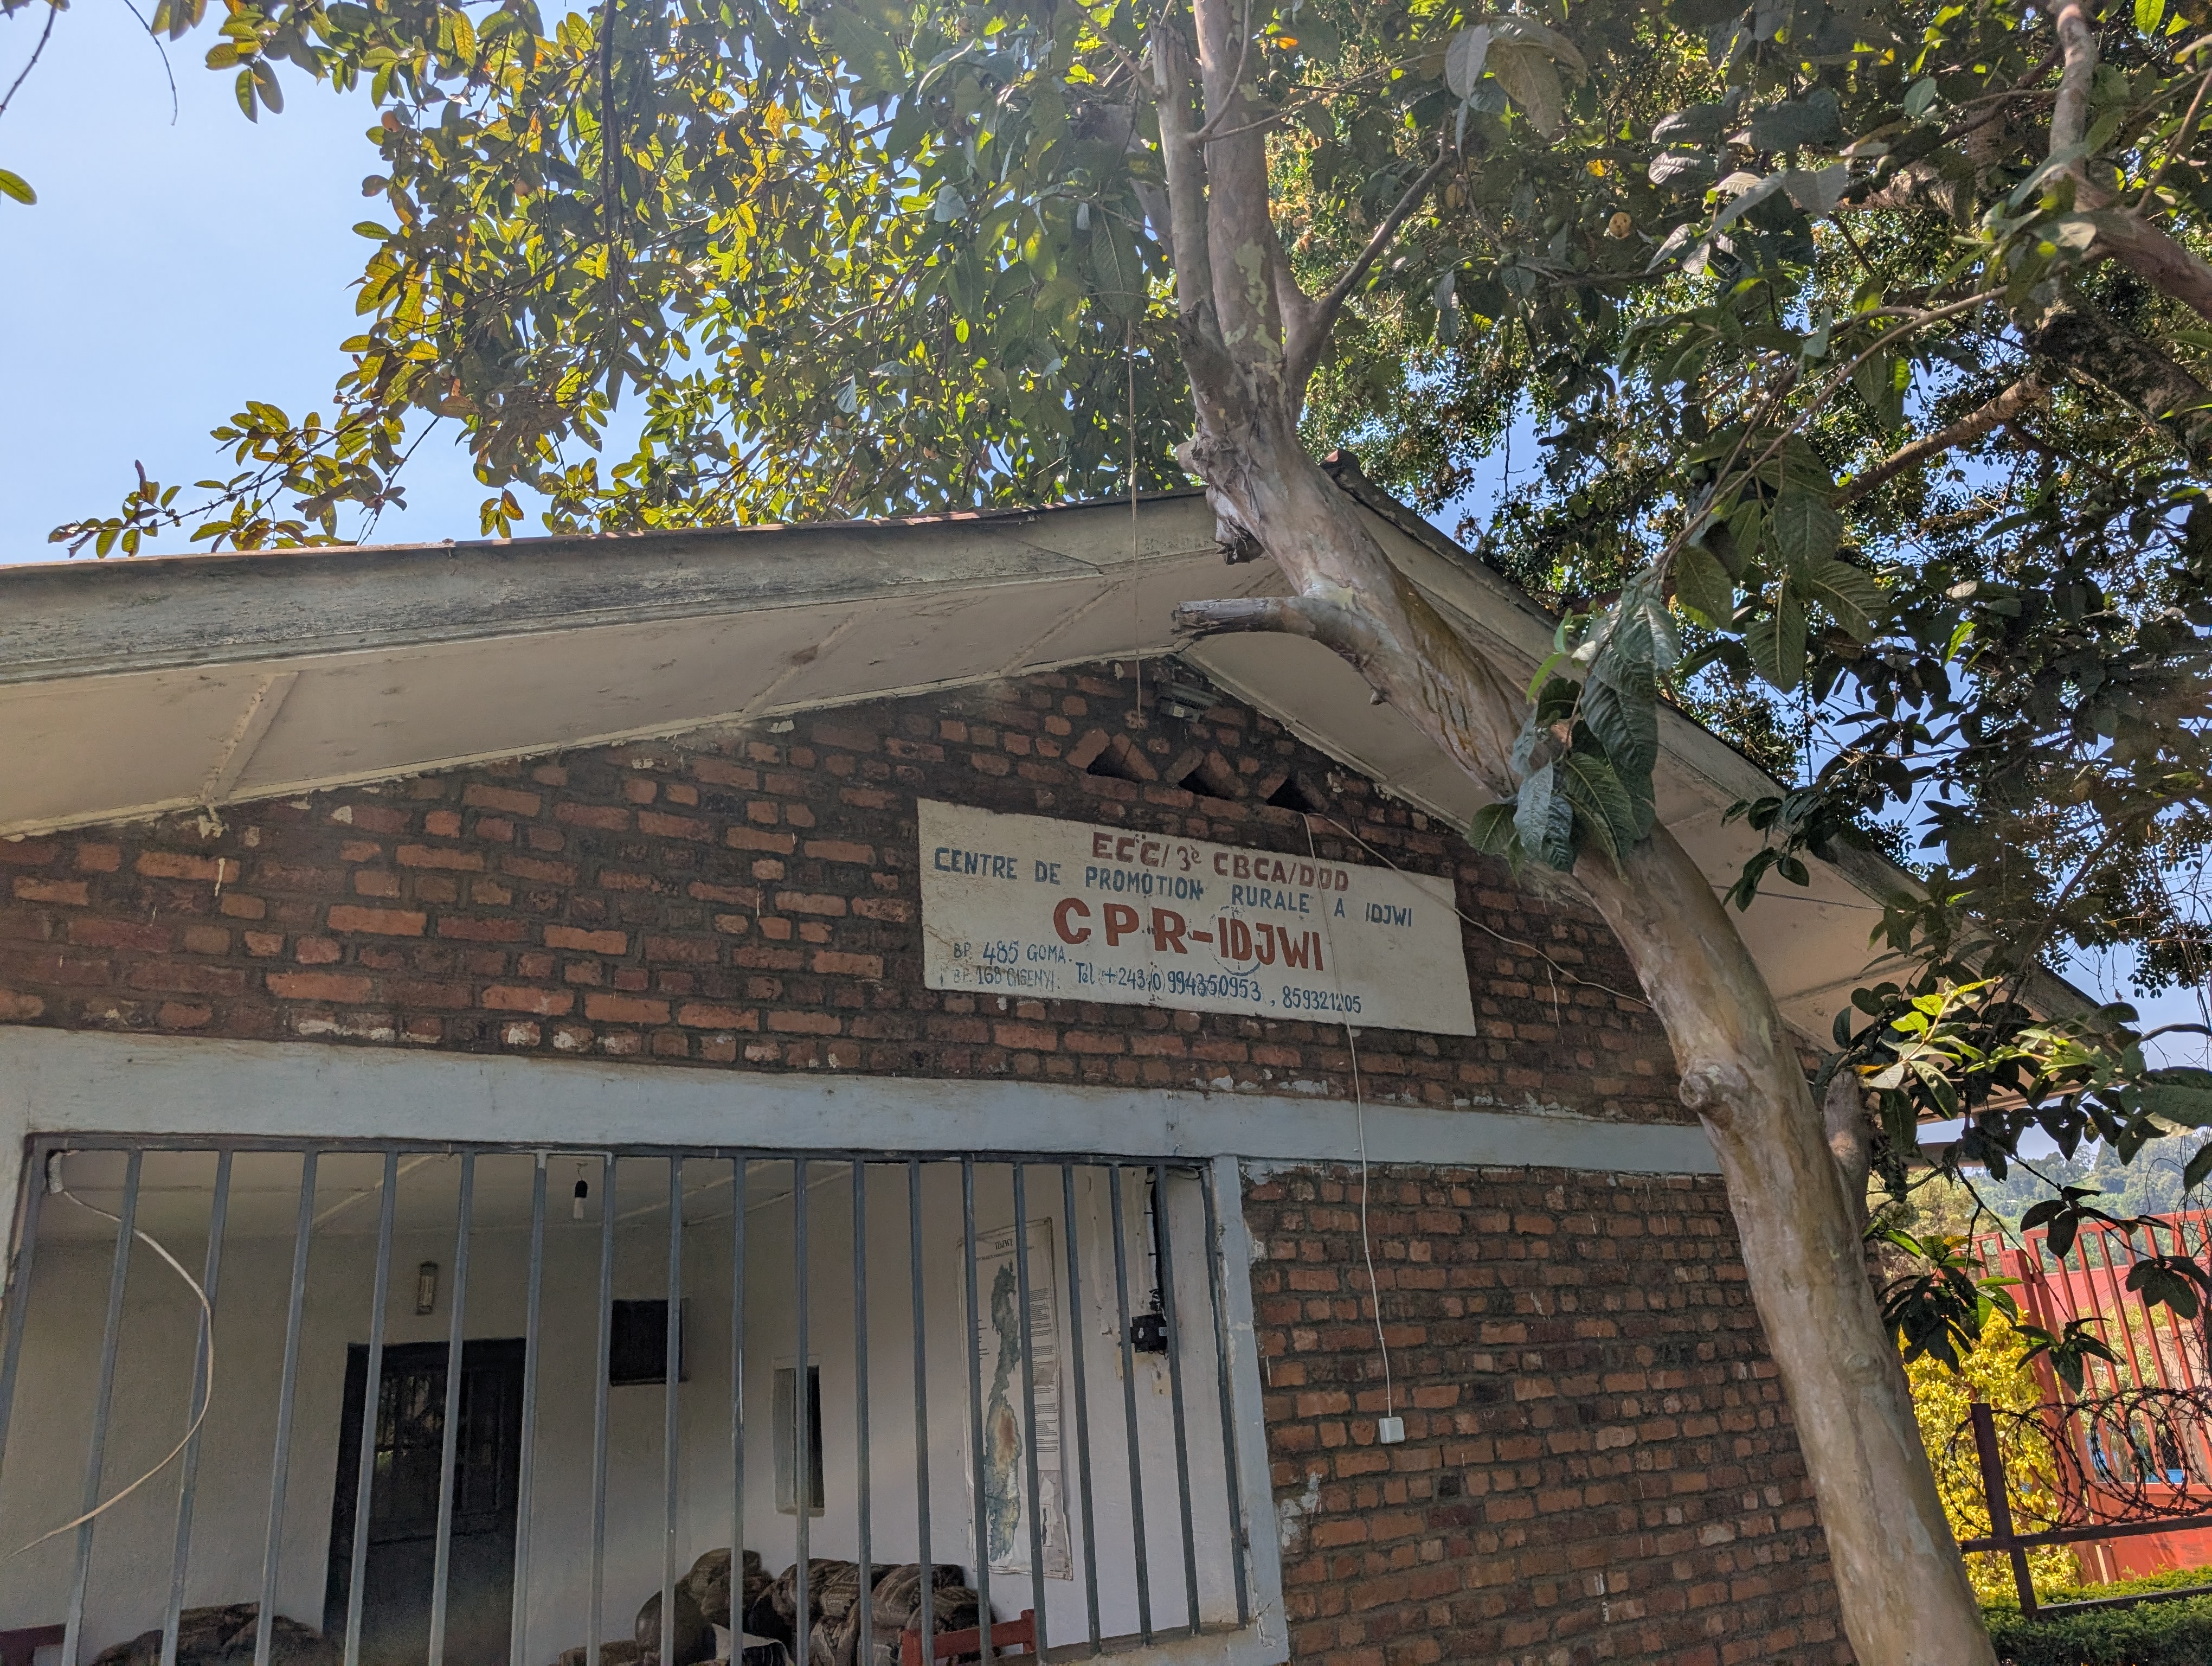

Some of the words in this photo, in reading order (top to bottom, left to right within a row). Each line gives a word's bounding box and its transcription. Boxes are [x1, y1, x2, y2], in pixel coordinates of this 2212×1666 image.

[934, 847, 1018, 880] CENTRE
[1034, 860, 1061, 885] DE
[1086, 866, 1204, 901] PROMOTION
[1232, 884, 1310, 913] RURALE
[1334, 898, 1345, 918] A
[1365, 902, 1412, 927] IDJWI
[983, 940, 1019, 965] 485
[976, 965, 1002, 985] 168
